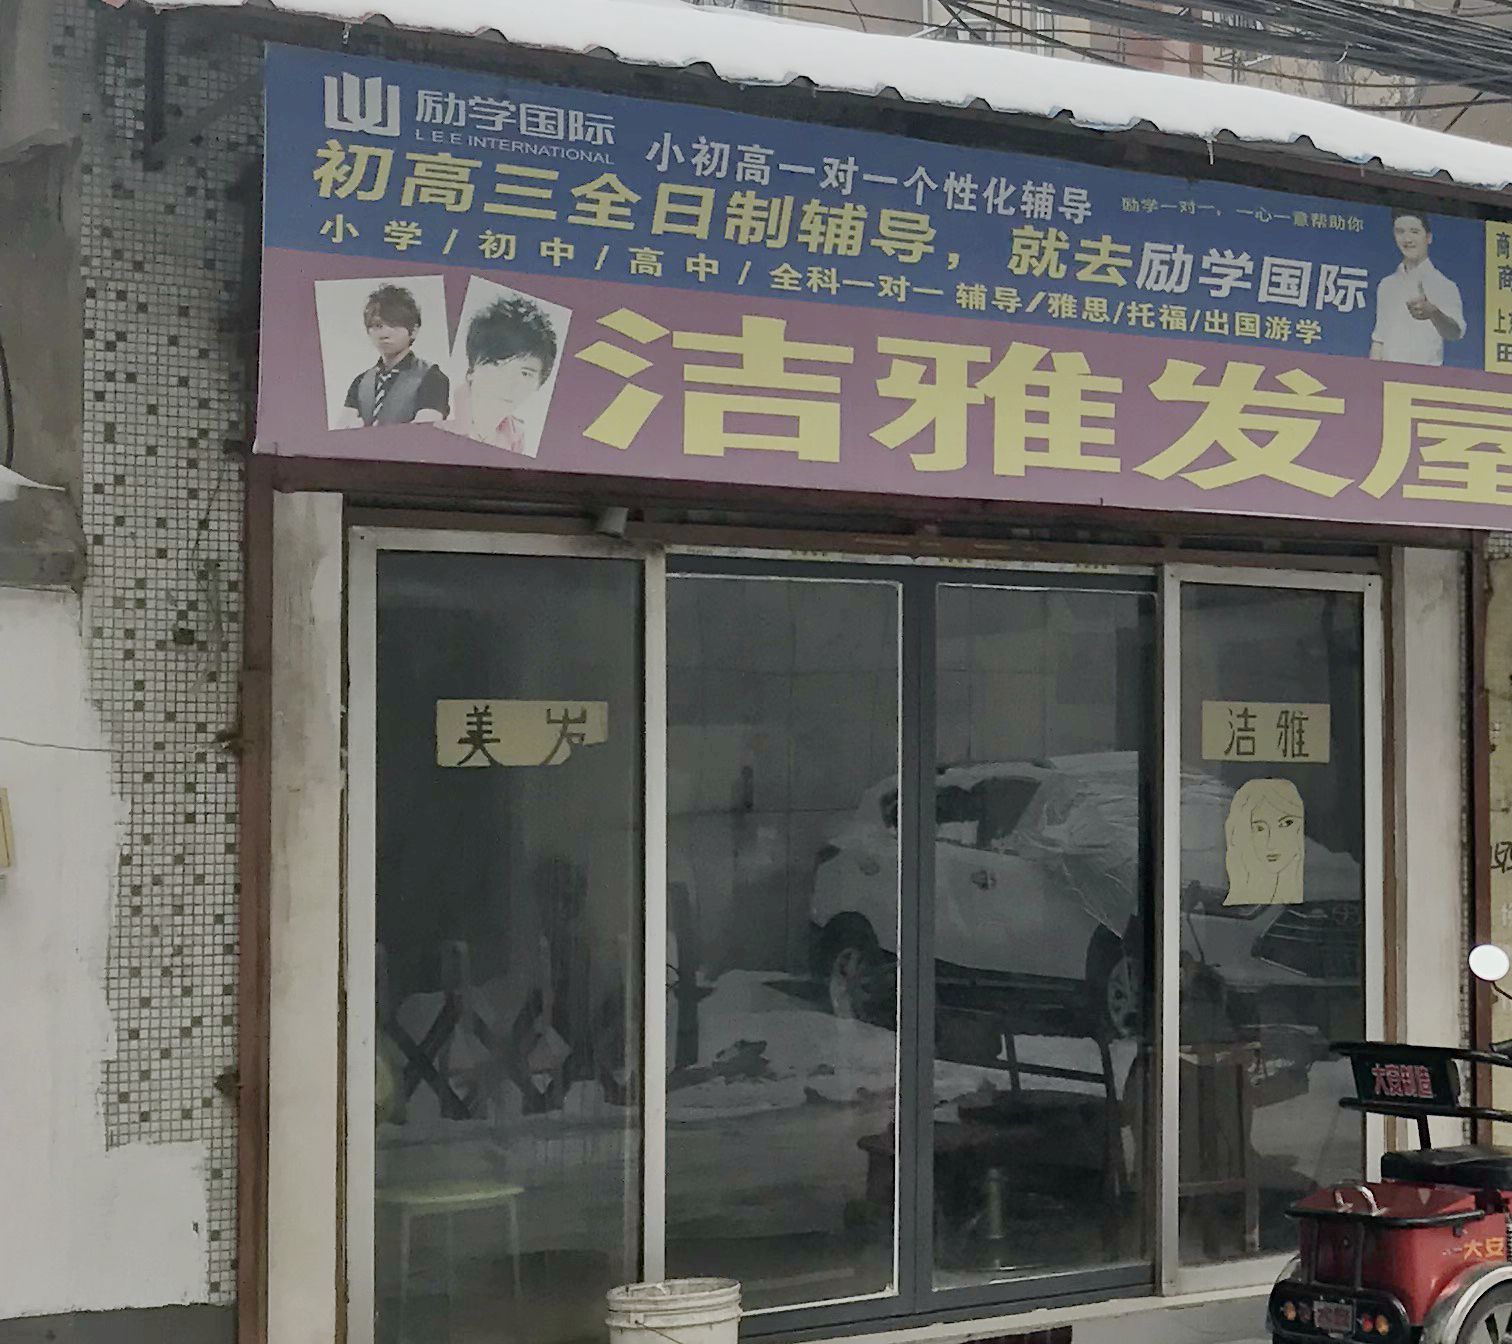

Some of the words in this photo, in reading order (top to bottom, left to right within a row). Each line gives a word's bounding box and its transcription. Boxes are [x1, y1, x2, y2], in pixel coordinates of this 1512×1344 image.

[416, 90, 616, 145] 励学国际
[415, 129, 463, 146] LEE
[468, 136, 615, 165] INTERNATIONAL
[646, 132, 1092, 224] 小初高一对一个性化辅导
[1223, 706, 1310, 759] 洁雅
